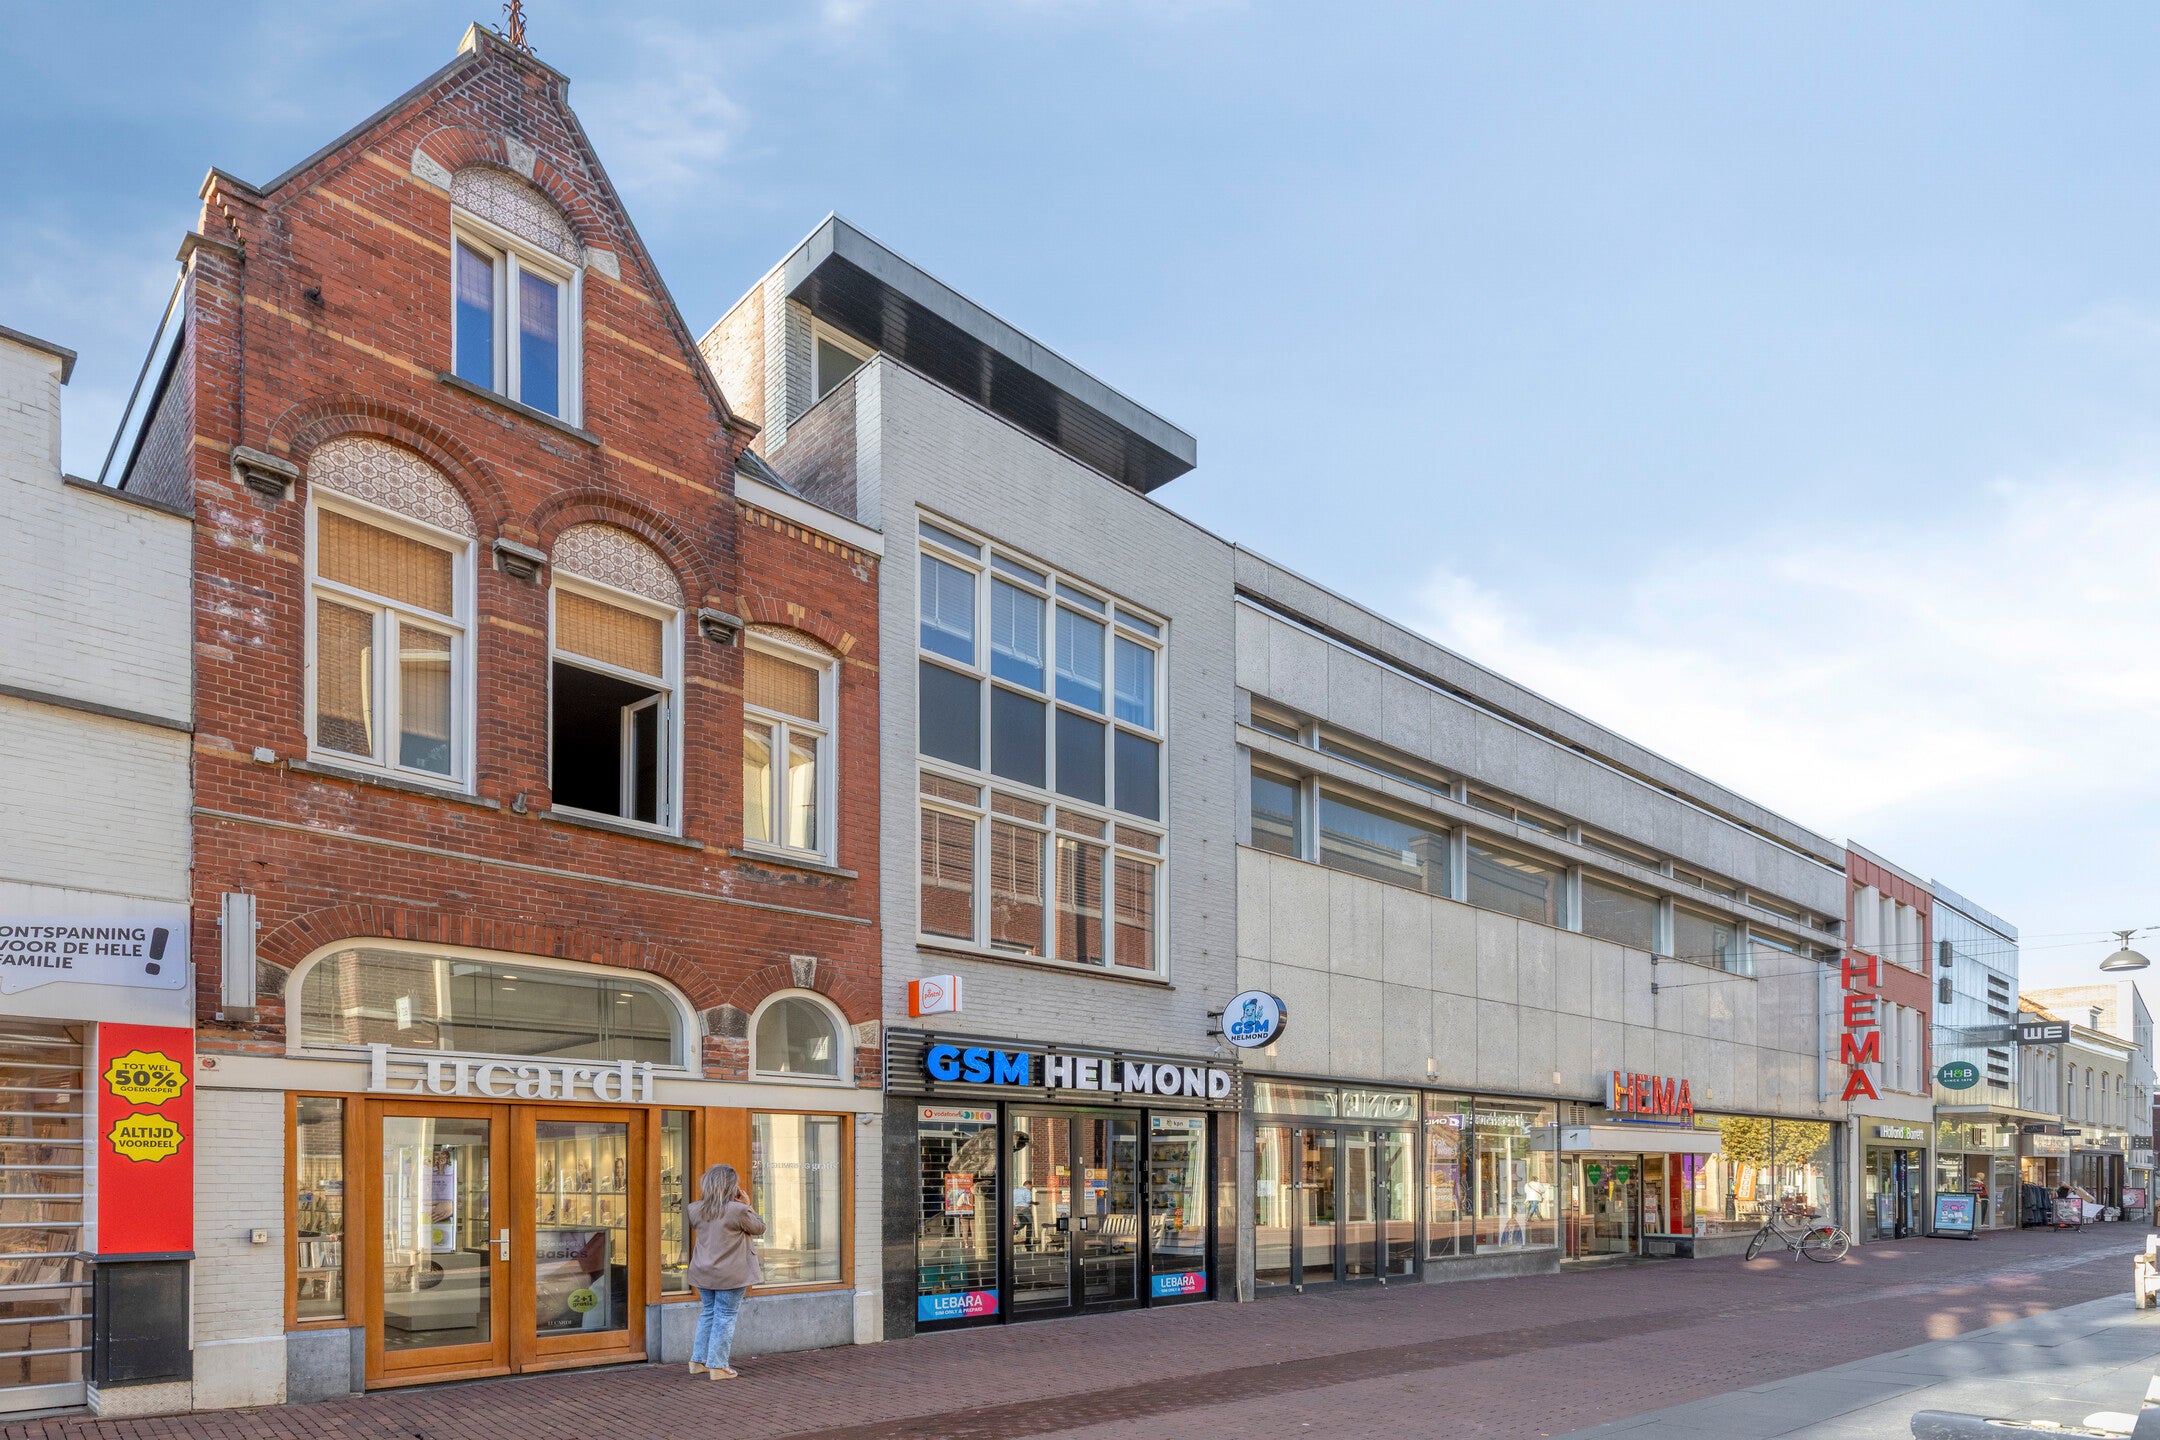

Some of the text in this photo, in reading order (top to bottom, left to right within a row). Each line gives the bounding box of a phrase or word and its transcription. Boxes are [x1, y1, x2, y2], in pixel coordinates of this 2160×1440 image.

[0, 926, 146, 941] ONTSPANNING
[63, 942, 89, 955] DE
[95, 943, 143, 957] HELE
[1231, 1019, 1269, 1035] GSM
[1841, 955, 1880, 1101] HEMA
[2024, 1026, 2062, 1040] WE
[1231, 1033, 1269, 1041] HELMOND
[115, 1069, 178, 1087] 50%
[367, 1042, 656, 1103] Lucardi
[927, 1044, 1231, 1099] GSM HELMOND
[1943, 1069, 1973, 1078] H&B
[1613, 1071, 1694, 1116] HEMA
[120, 1127, 173, 1138] ALTIJD
[119, 1140, 174, 1148] VOORDEEL
[537, 1248, 588, 1259] Basics
[1160, 1276, 1195, 1288] LEBARA
[934, 1295, 983, 1310] LEBARA
